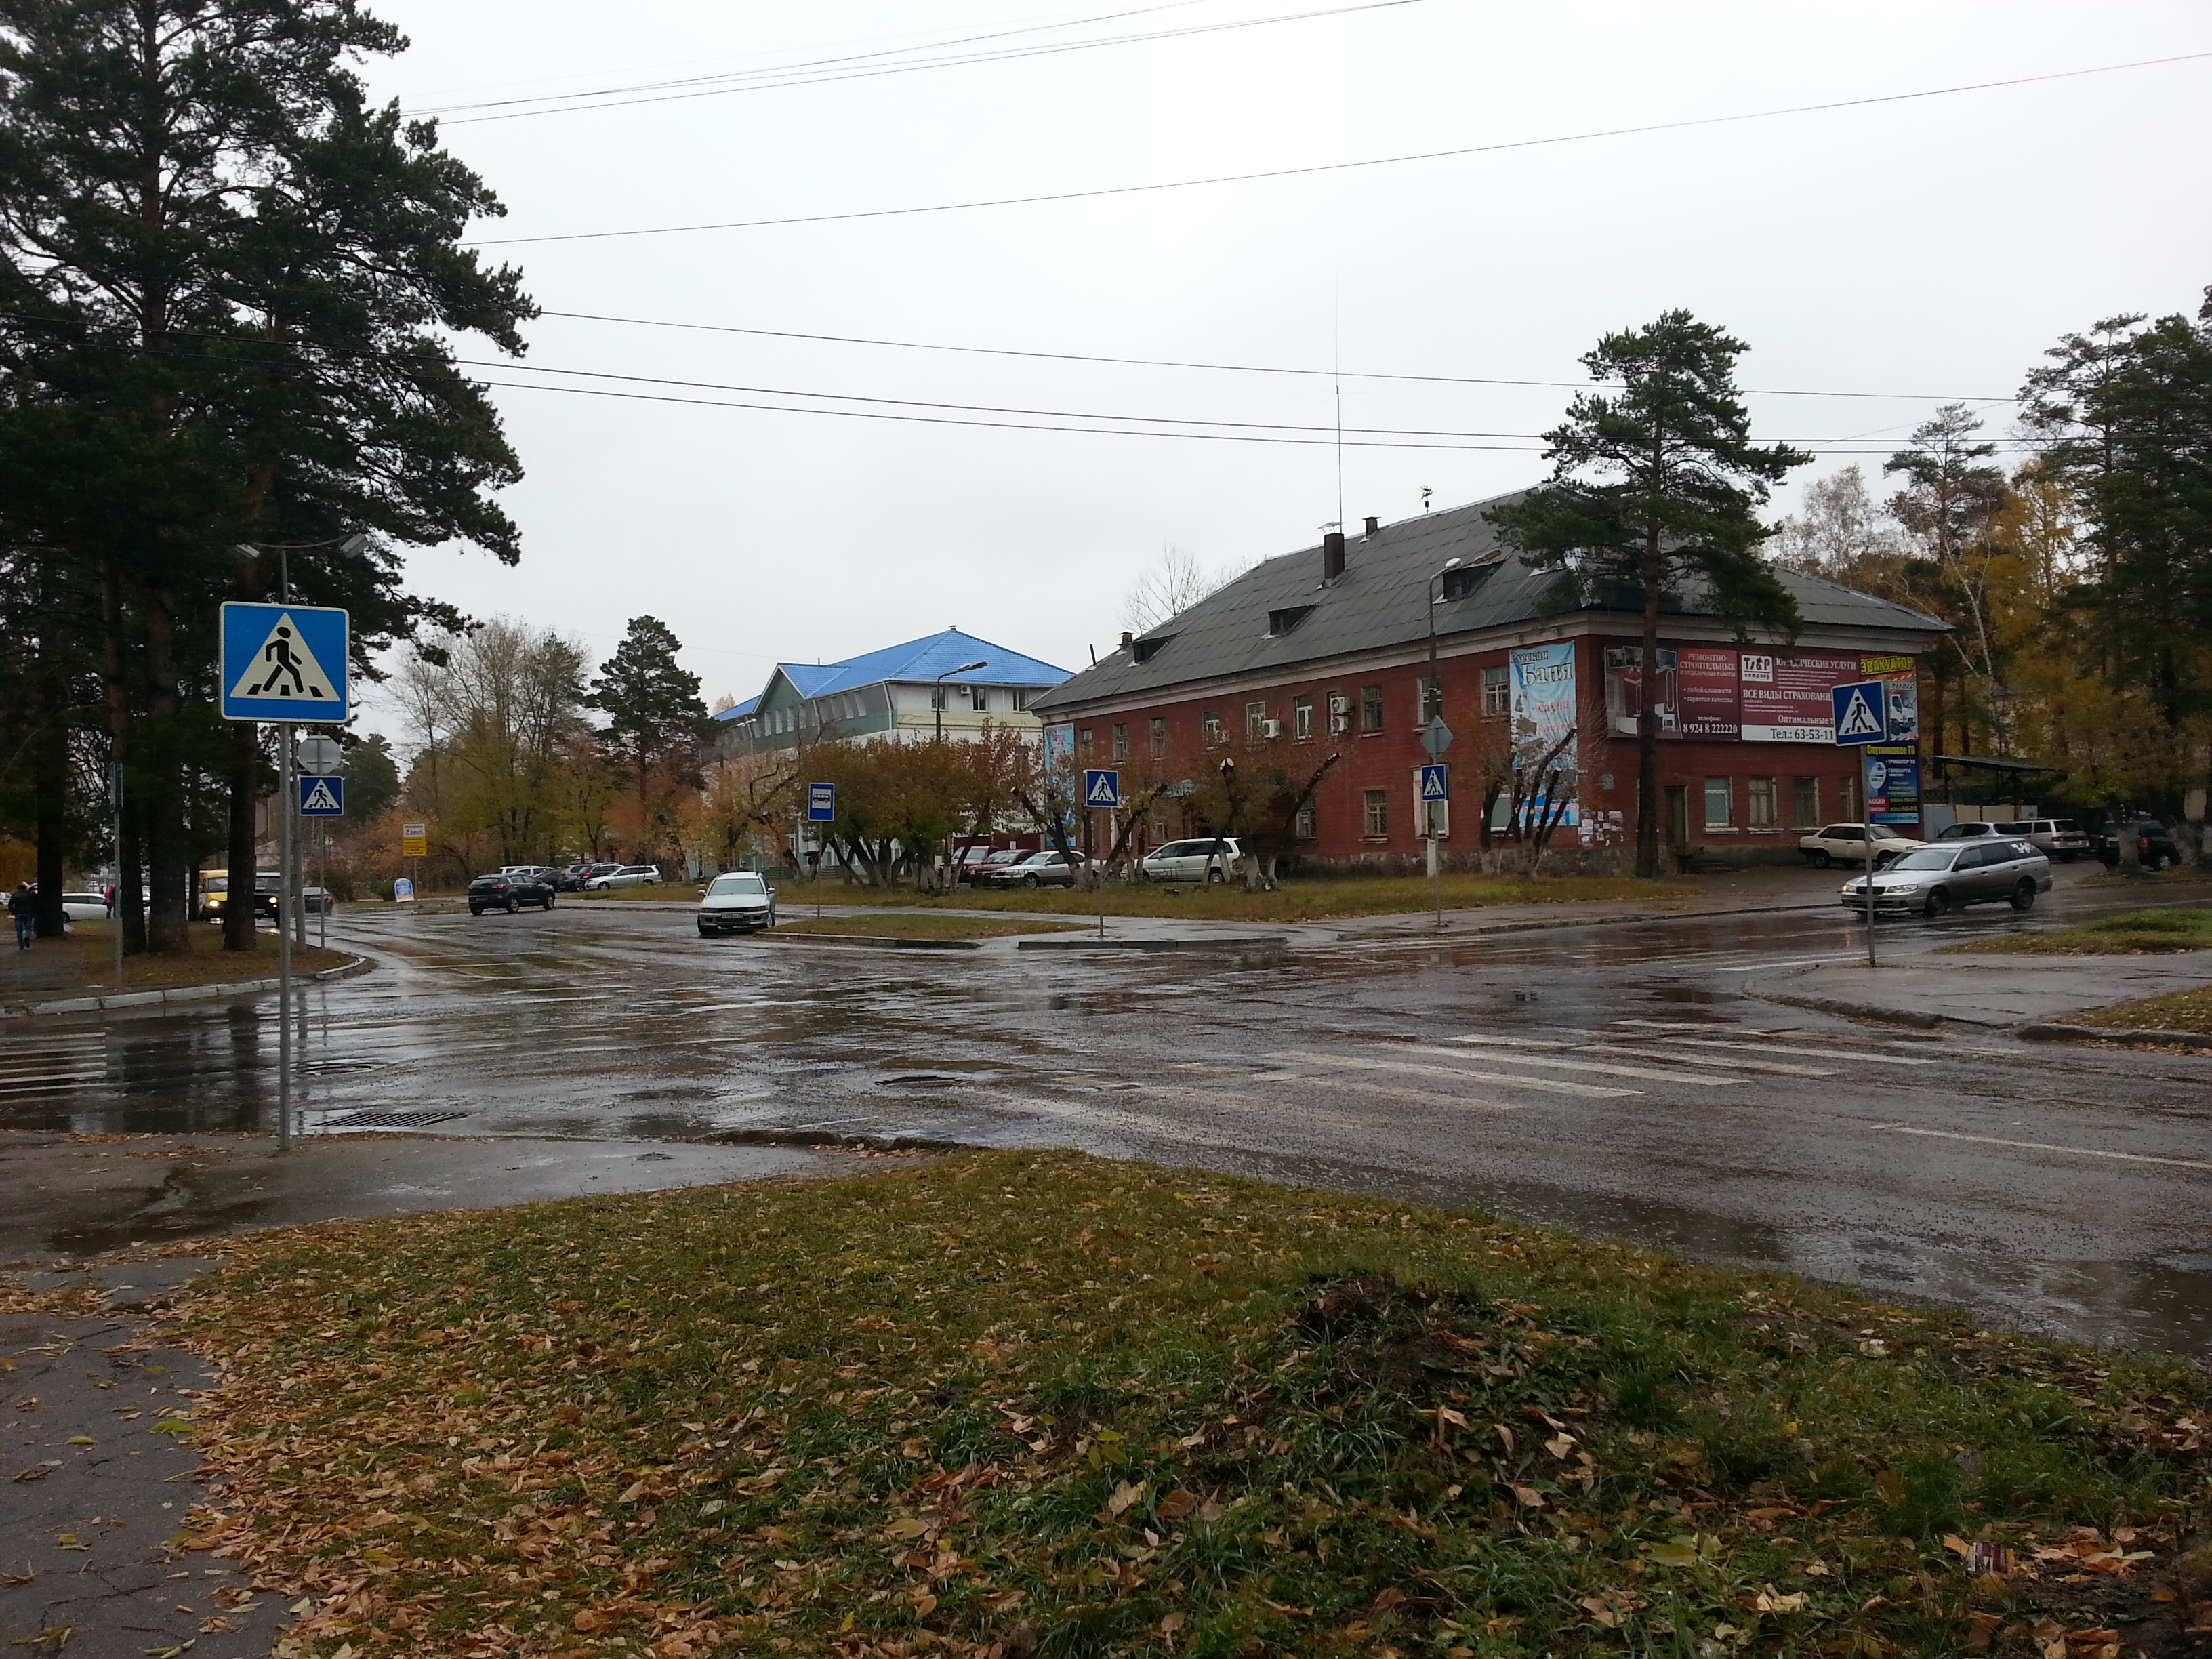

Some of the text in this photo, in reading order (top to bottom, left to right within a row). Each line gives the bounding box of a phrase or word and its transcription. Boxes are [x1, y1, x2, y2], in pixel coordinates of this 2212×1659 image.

[1510, 651, 1548, 663] Русская
[1688, 653, 1728, 662] РЕМОНТНО-
[1680, 661, 1736, 670] СТРОИТЕЛЬНЫЕ
[1830, 661, 1856, 670] УСЛУГИ
[1861, 657, 1914, 674] ЭВАКУАТОР
[1520, 662, 1573, 686] Баня
[1743, 689, 1832, 701] ВСЕ ВИДЫ СТРАХОВАНИ
[1538, 700, 1570, 714] сауна
[1778, 714, 1829, 724] Оптимальные
[1683, 723, 1738, 734] 8 924 8 222220
[1771, 729, 1834, 740] Тел.: 63-53-11
[1867, 745, 1916, 756] Спутниковое ТВ
